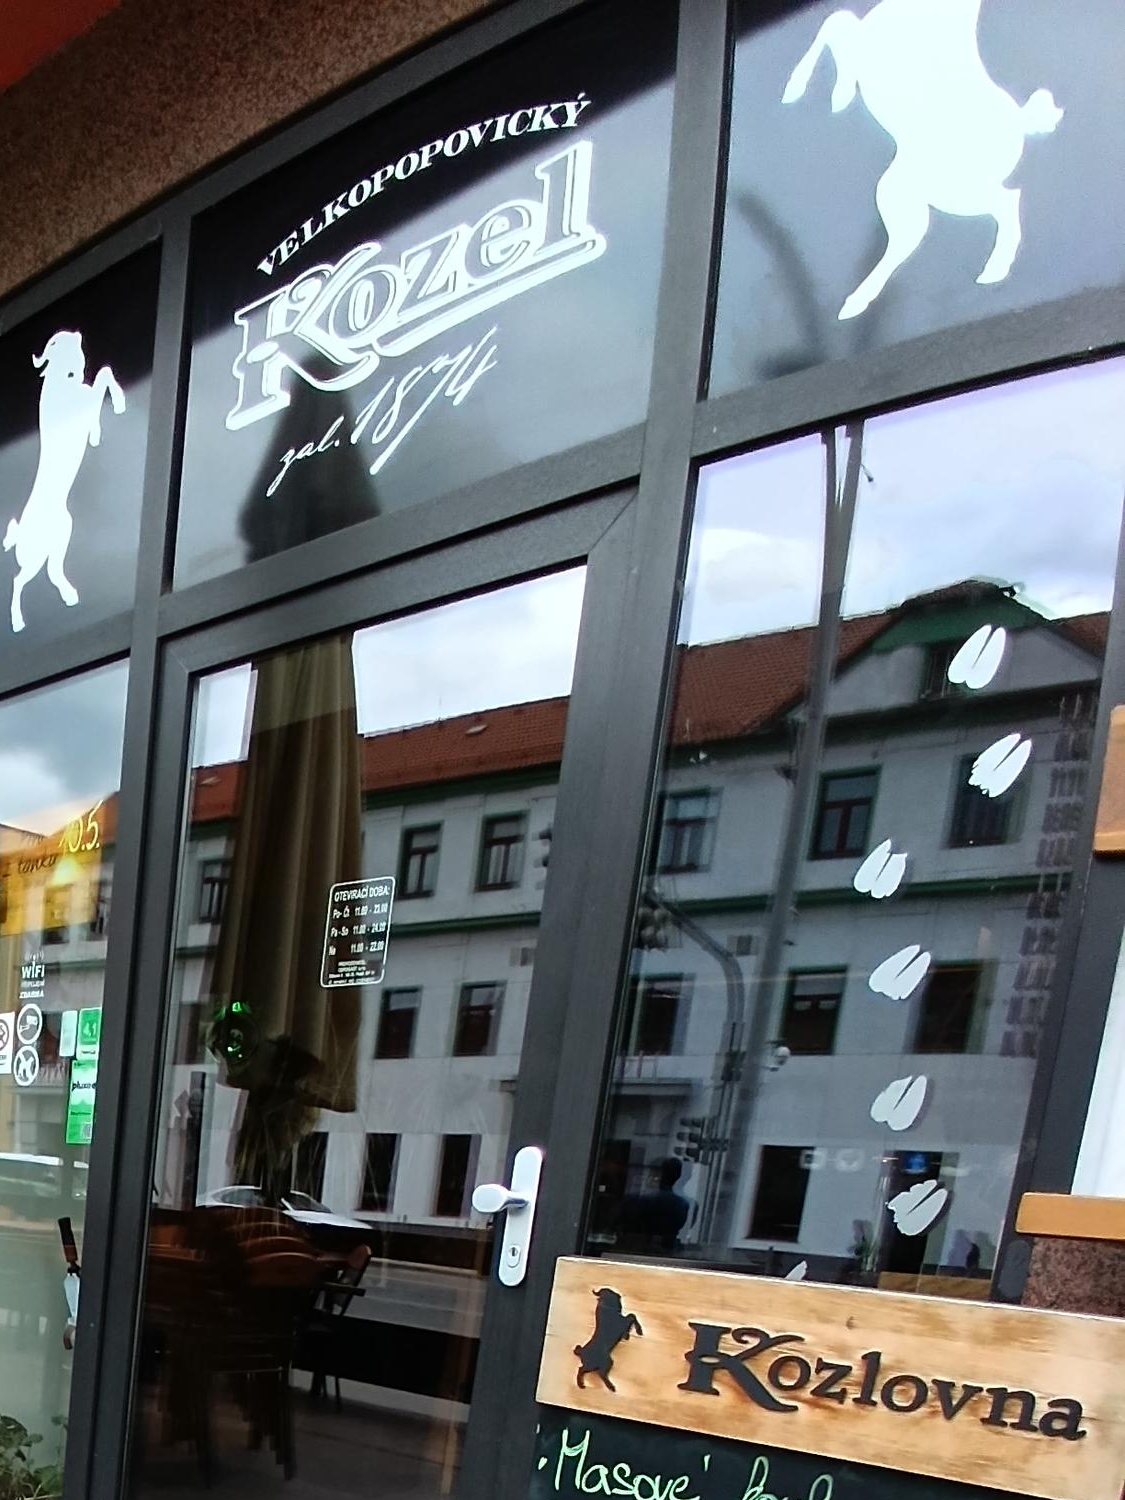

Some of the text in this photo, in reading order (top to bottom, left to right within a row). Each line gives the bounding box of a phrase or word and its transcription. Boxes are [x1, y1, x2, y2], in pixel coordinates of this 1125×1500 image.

[257, 92, 591, 276] VELKOPOPOVICKÝ
[226, 139, 606, 430] Kozel
[266, 326, 497, 497] zal. 1874
[21, 961, 45, 979] WIFI
[677, 1320, 1087, 1441] Kozlovna
